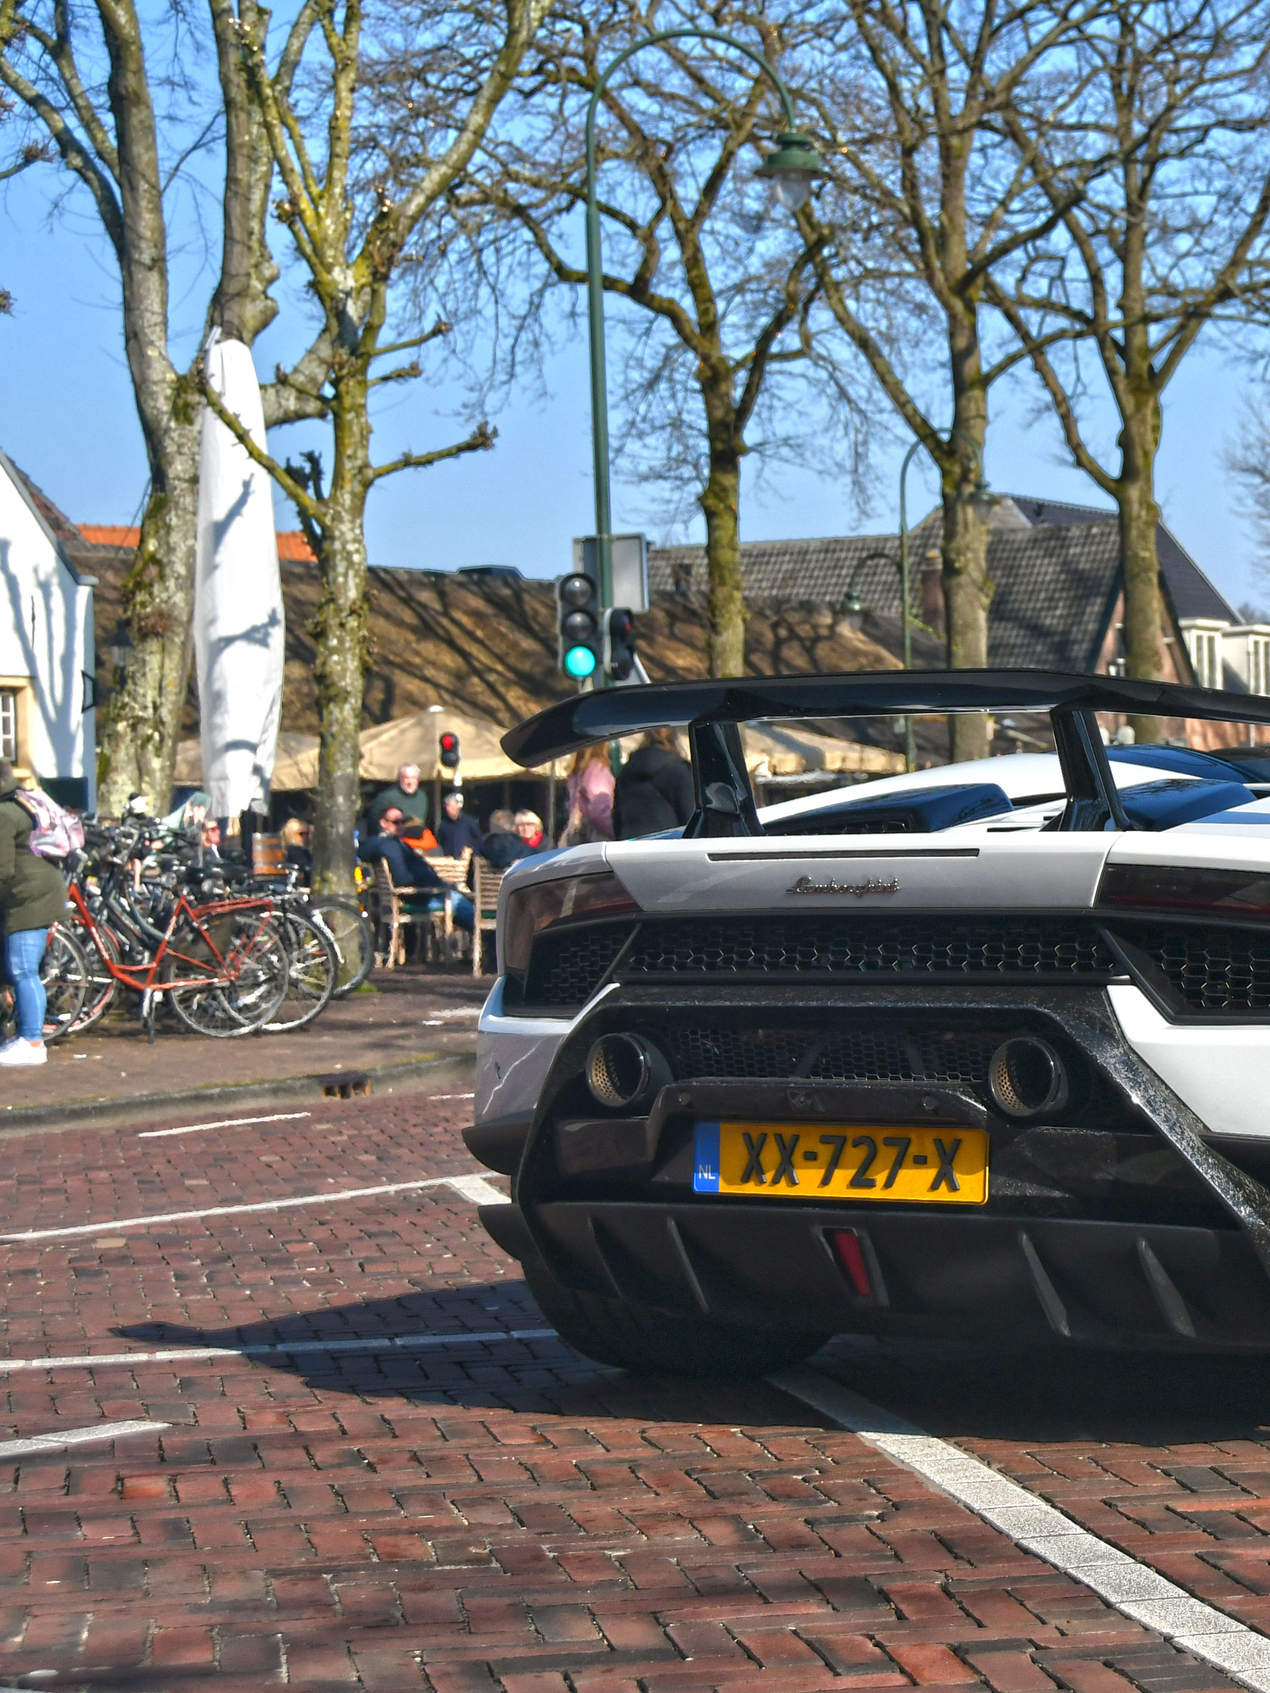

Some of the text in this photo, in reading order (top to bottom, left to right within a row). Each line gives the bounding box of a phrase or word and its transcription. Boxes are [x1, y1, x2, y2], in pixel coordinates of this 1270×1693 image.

[785, 876, 900, 898] Lamborghini
[698, 1164, 716, 1180] NL
[740, 1132, 962, 1192] XX-727-X
